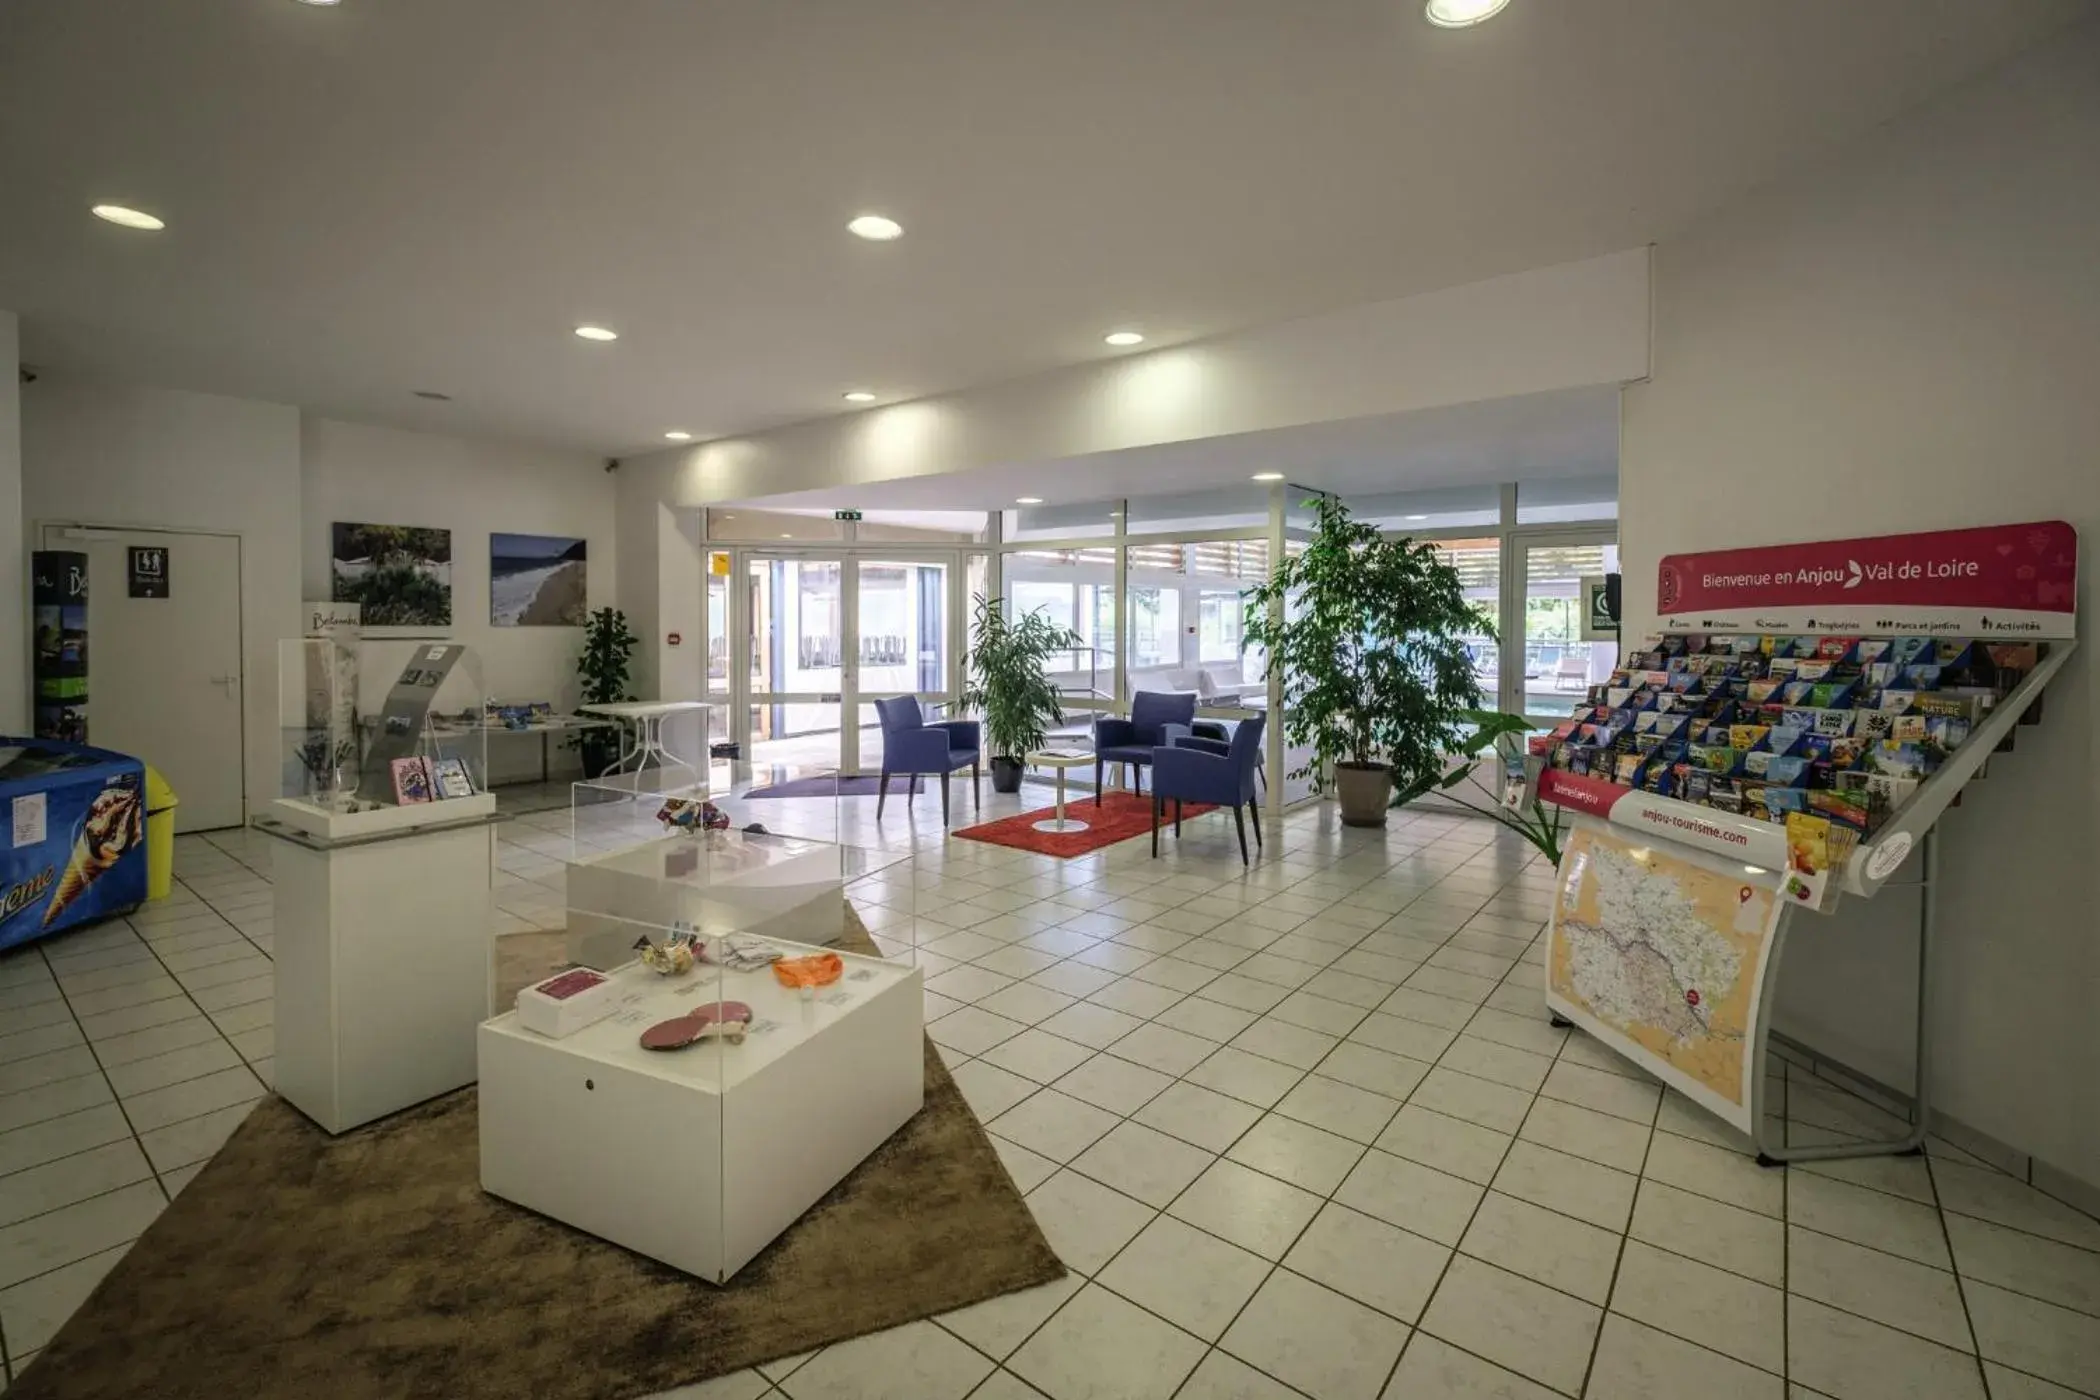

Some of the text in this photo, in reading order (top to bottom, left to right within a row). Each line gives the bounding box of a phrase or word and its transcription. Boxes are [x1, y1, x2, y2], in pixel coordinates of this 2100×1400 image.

[1703, 559, 1980, 589] Bienvenue en Anjou Val de Loire
[1995, 620, 2041, 631] Activités
[1641, 807, 1748, 846] anjou-tourisme.com
